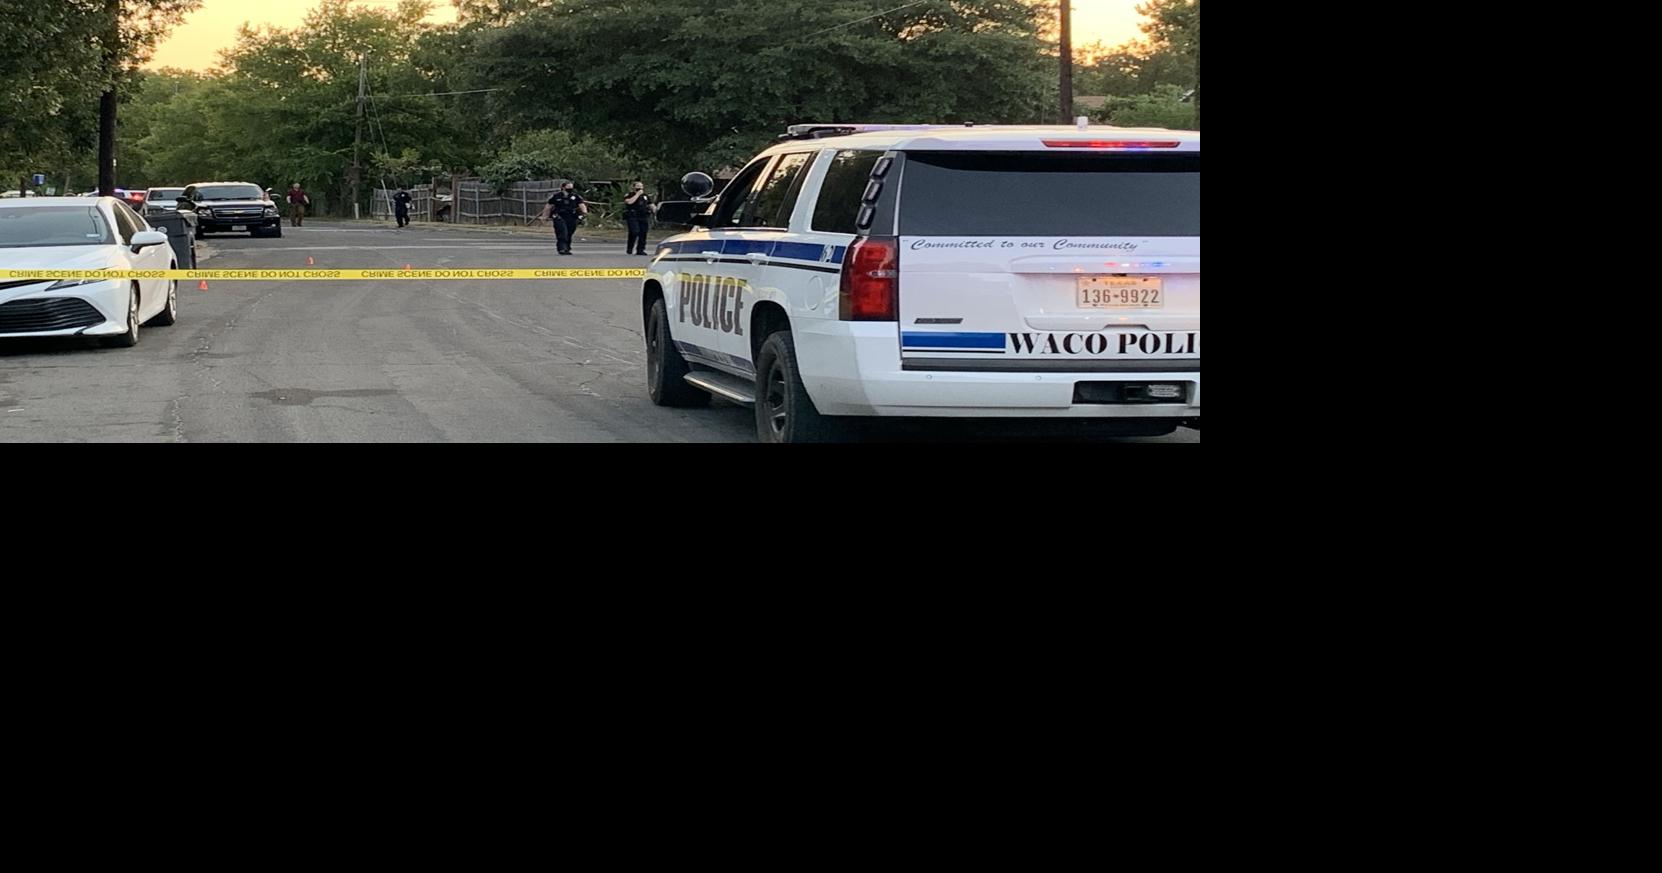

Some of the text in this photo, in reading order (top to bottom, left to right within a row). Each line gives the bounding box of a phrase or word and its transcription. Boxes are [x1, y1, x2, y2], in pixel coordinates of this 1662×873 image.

[1000, 240, 1014, 248] to
[679, 272, 747, 336] POLICE
[1009, 332, 1108, 354] WACO
